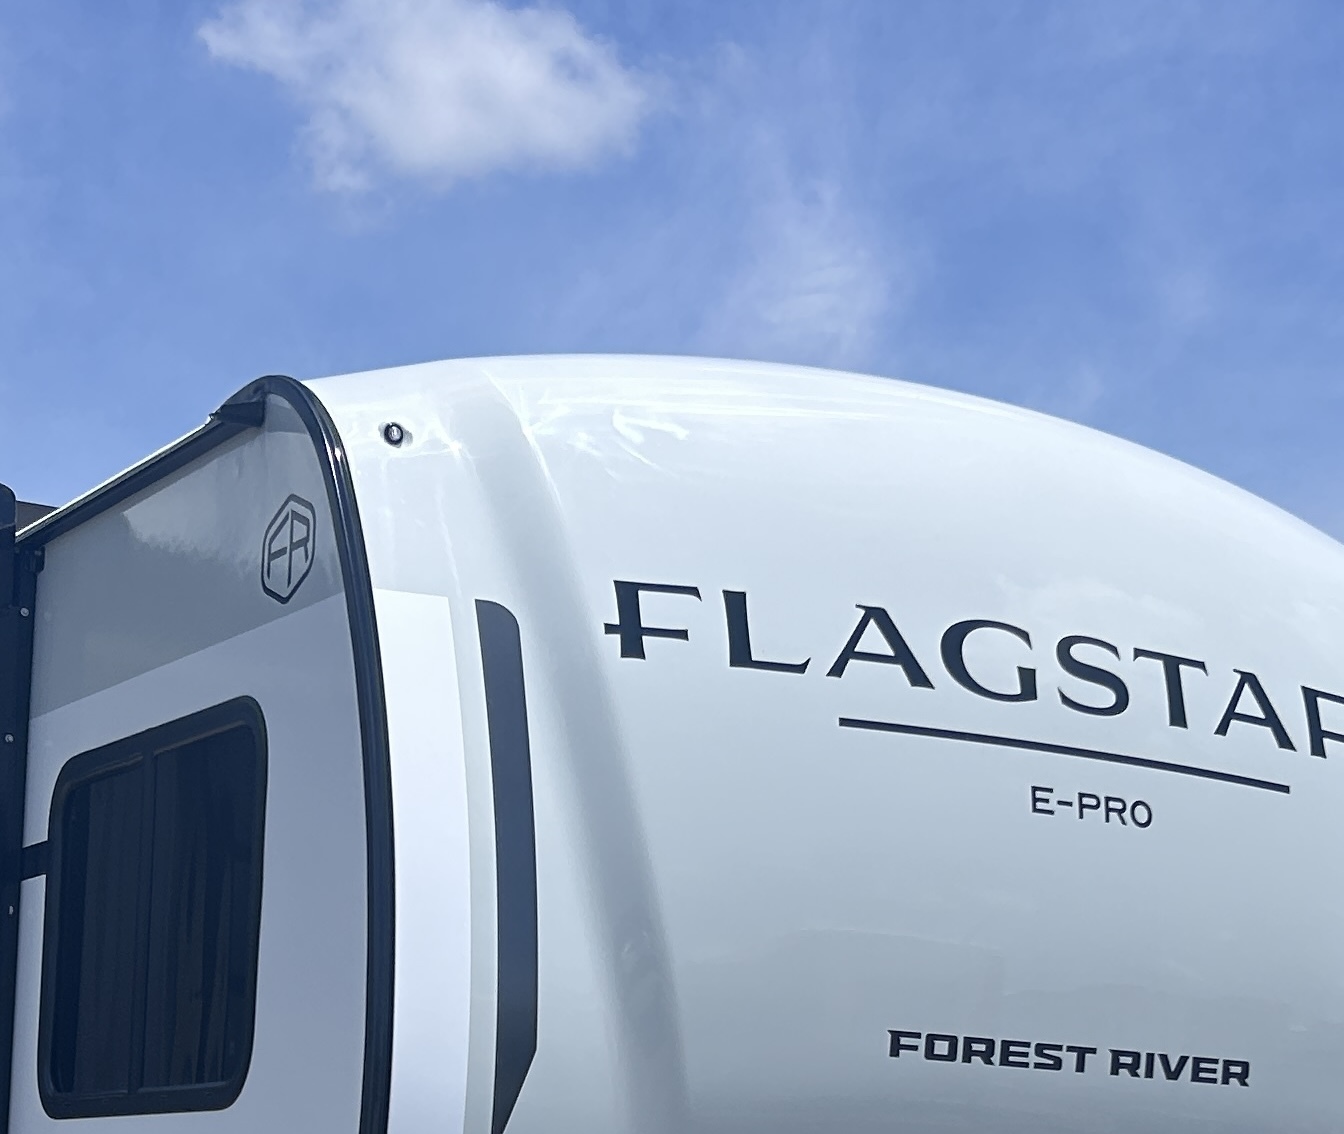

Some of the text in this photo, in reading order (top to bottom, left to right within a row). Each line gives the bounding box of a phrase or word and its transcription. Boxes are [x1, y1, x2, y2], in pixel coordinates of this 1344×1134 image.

[1031, 786, 1153, 829] E-PRO
[887, 1029, 1250, 1087] FOREST RIVER
